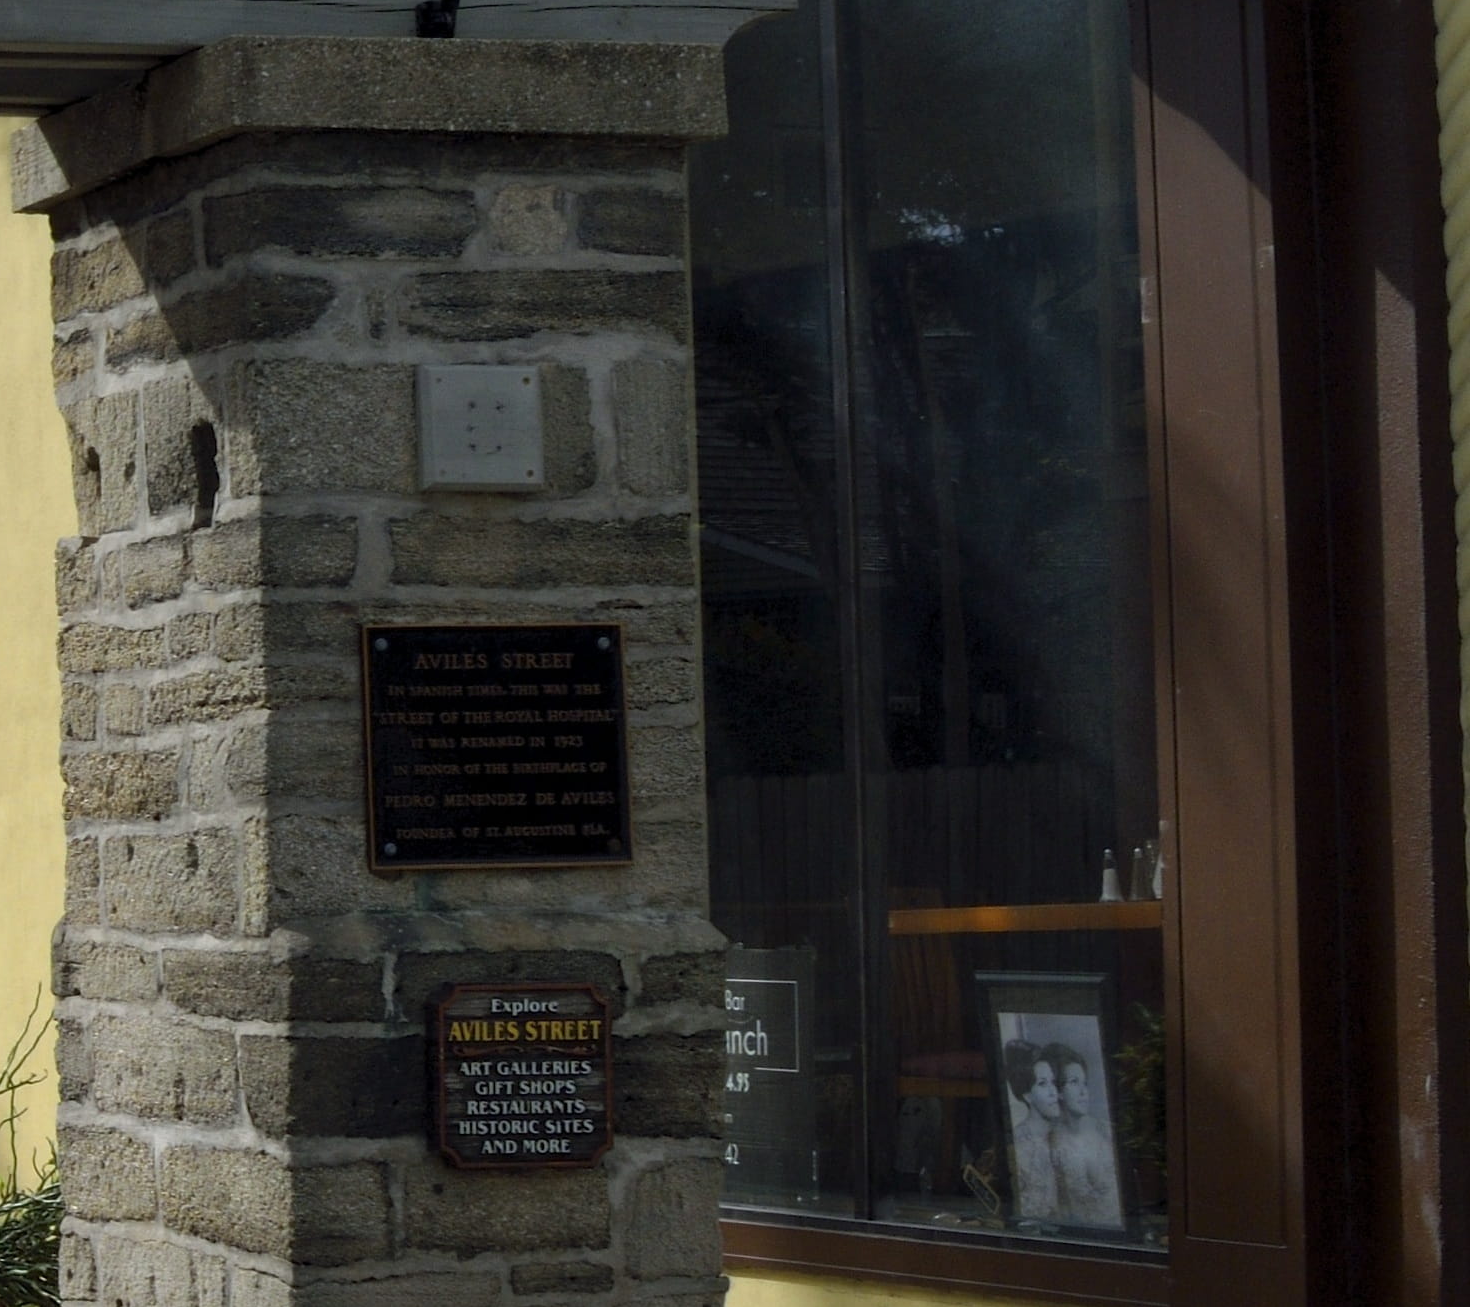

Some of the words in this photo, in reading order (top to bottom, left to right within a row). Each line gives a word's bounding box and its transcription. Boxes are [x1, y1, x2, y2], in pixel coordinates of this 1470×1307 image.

[414, 652, 488, 670] AVILES
[502, 652, 576, 669] STREET
[575, 683, 602, 695] THE
[439, 711, 459, 725] OF
[463, 711, 492, 724] THE
[495, 710, 543, 724] ROYAL
[528, 735, 545, 747] IN
[412, 764, 461, 775] HONOR
[463, 764, 482, 775] OF
[484, 763, 509, 775] THE
[589, 761, 608, 773] OF
[384, 794, 436, 808] PEDRO
[443, 793, 528, 807] MENENDEZ
[535, 792, 556, 806] DE
[560, 791, 615, 805] AVILES
[461, 826, 481, 839] OF
[491, 998, 560, 1016] Explore
[448, 1021, 520, 1042] AVILES
[524, 1020, 602, 1041] STREET
[459, 1061, 492, 1076] ART
[496, 1060, 593, 1076] GALLERIES
[474, 1080, 515, 1095] GIFT
[519, 1079, 577, 1095] SHOPS
[467, 1099, 587, 1115] RESTAURANTS
[458, 1119, 540, 1135] HISTORIC
[544, 1118, 595, 1134] SITES
[481, 1140, 518, 1154] AND
[522, 1138, 572, 1154] MORE
